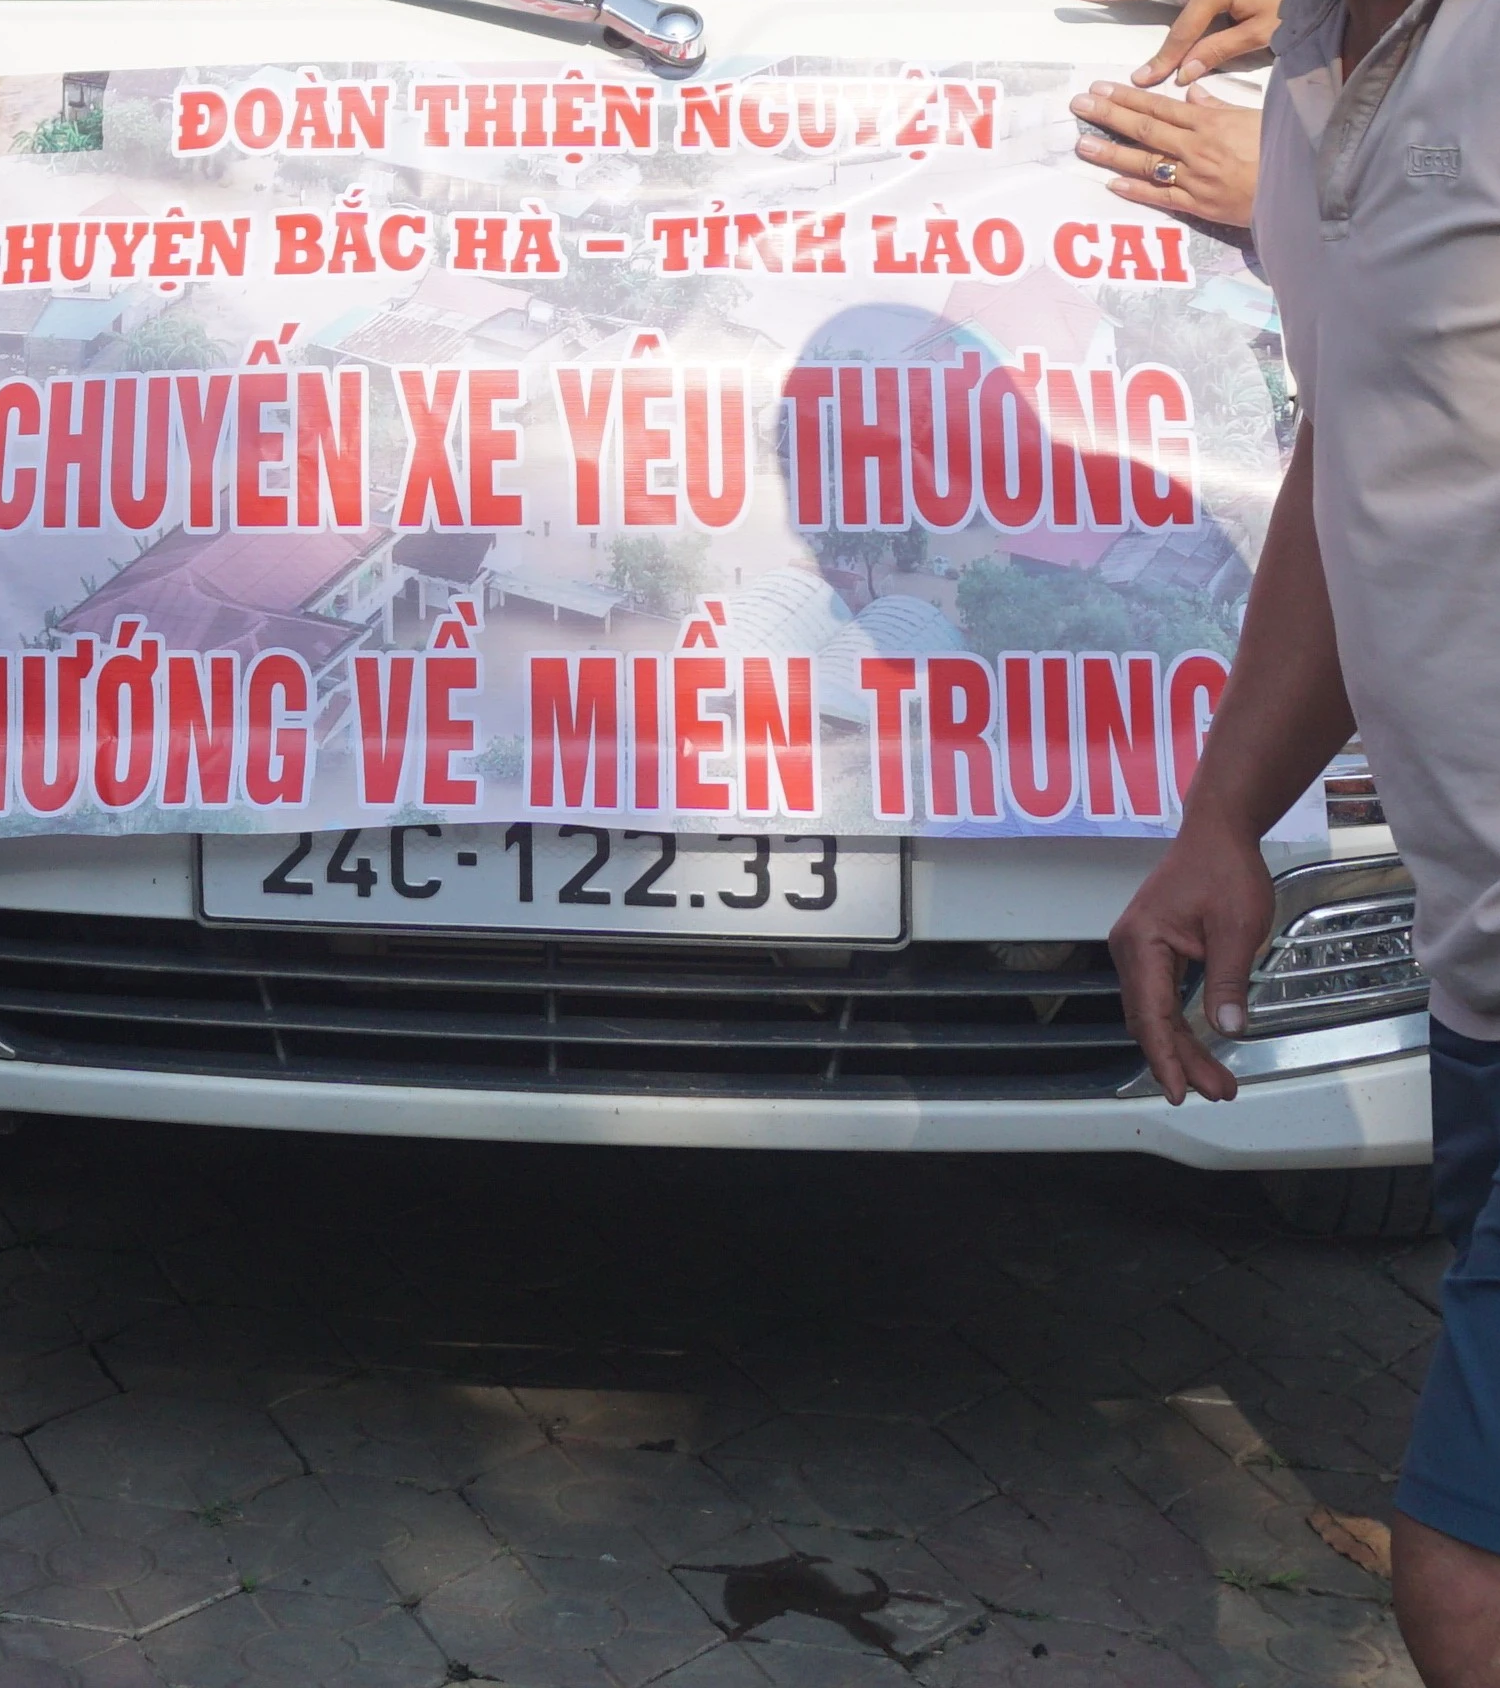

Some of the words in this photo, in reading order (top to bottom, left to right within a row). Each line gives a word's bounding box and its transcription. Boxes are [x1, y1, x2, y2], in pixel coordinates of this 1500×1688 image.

[178, 72, 389, 151] ĐOÀN
[415, 70, 655, 164] THIỆN
[680, 70, 997, 161] NGUYỆN
[2, 206, 251, 292] HUYỆN
[274, 188, 426, 275] BẮC
[453, 204, 561, 273] HÀ
[652, 200, 847, 274] TỈNH
[871, 202, 1026, 275] LÀO
[1053, 222, 1189, 283] CAI
[399, 368, 523, 527] XE
[556, 333, 746, 527] YÊU
[783, 350, 1194, 526] THƯƠNG
[354, 601, 478, 806] VỀ
[530, 600, 815, 811] MIỀN
[262, 821, 838, 911] 24C-122.33
